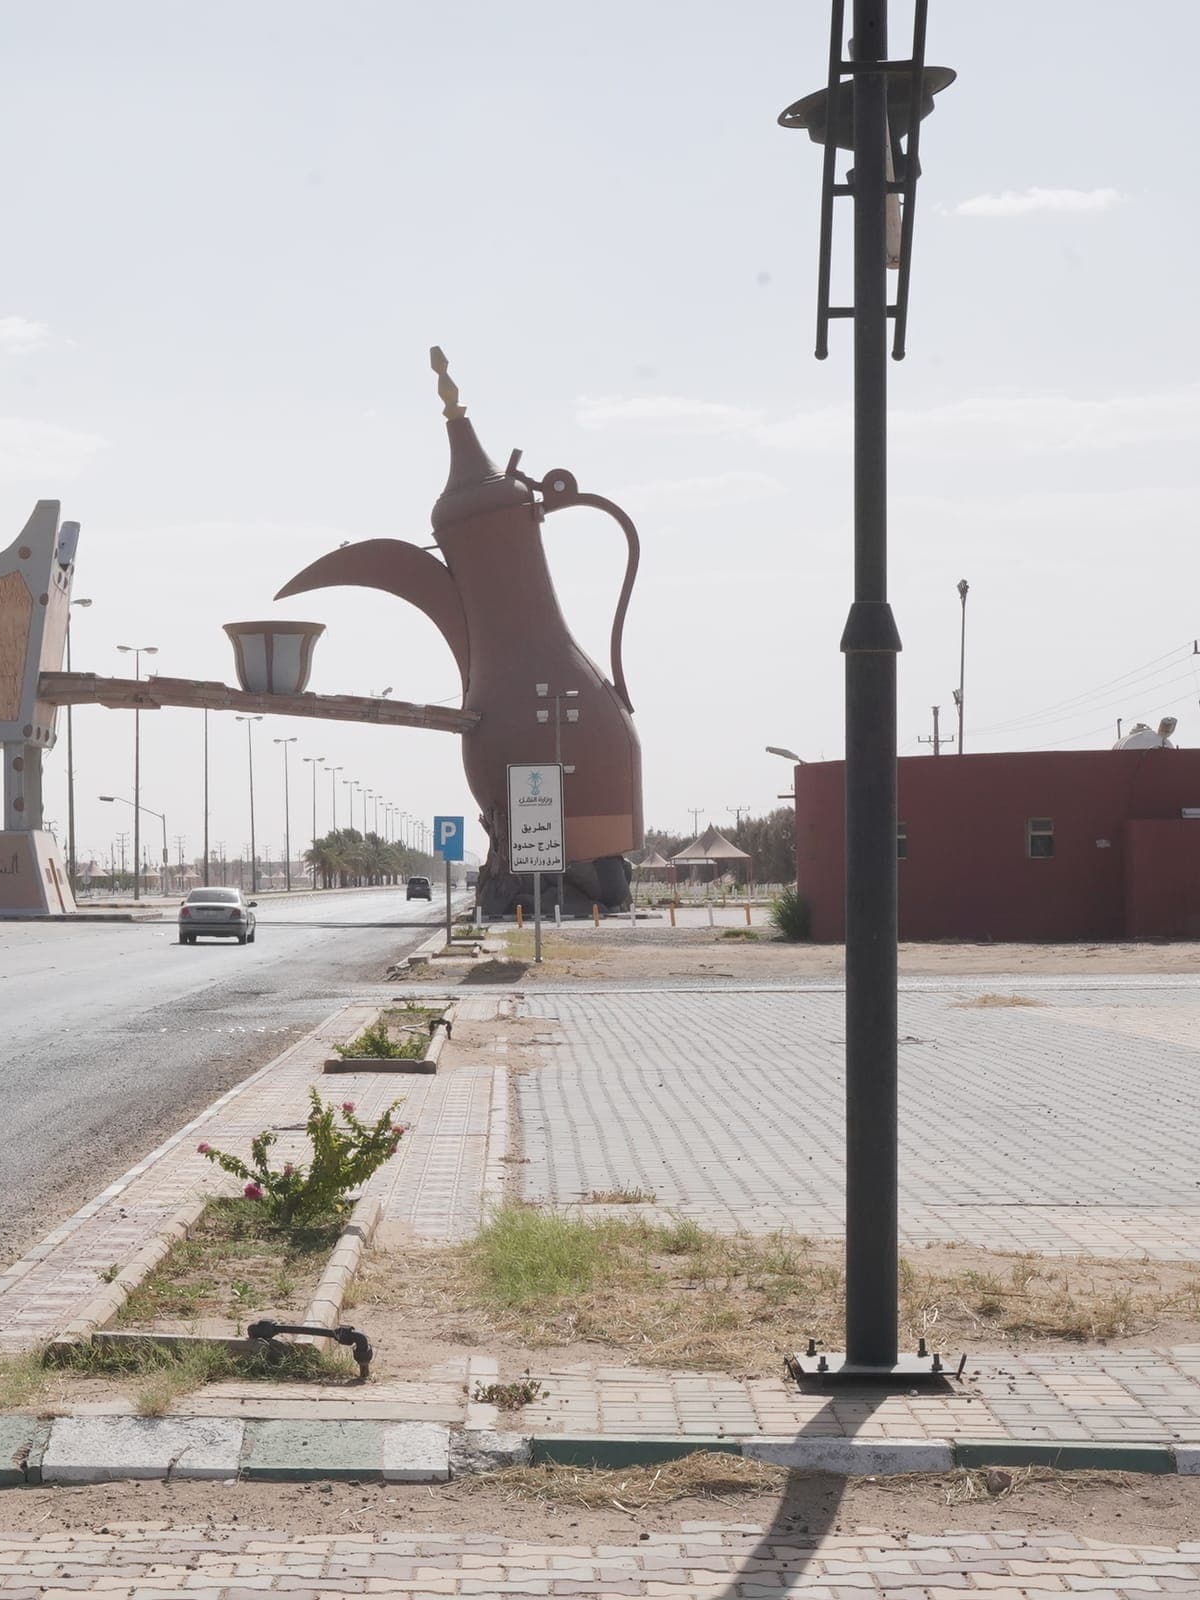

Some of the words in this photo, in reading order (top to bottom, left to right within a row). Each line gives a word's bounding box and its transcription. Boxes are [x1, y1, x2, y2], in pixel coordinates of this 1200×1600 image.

[521, 822, 551, 833] الطريق
[441, 821, 456, 845] P
[513, 842, 535, 851] حدود
[538, 839, 560, 851] خارج
[514, 856, 529, 866] النقل
[530, 856, 545, 866] وزارة
[546, 856, 560, 866] طرق
